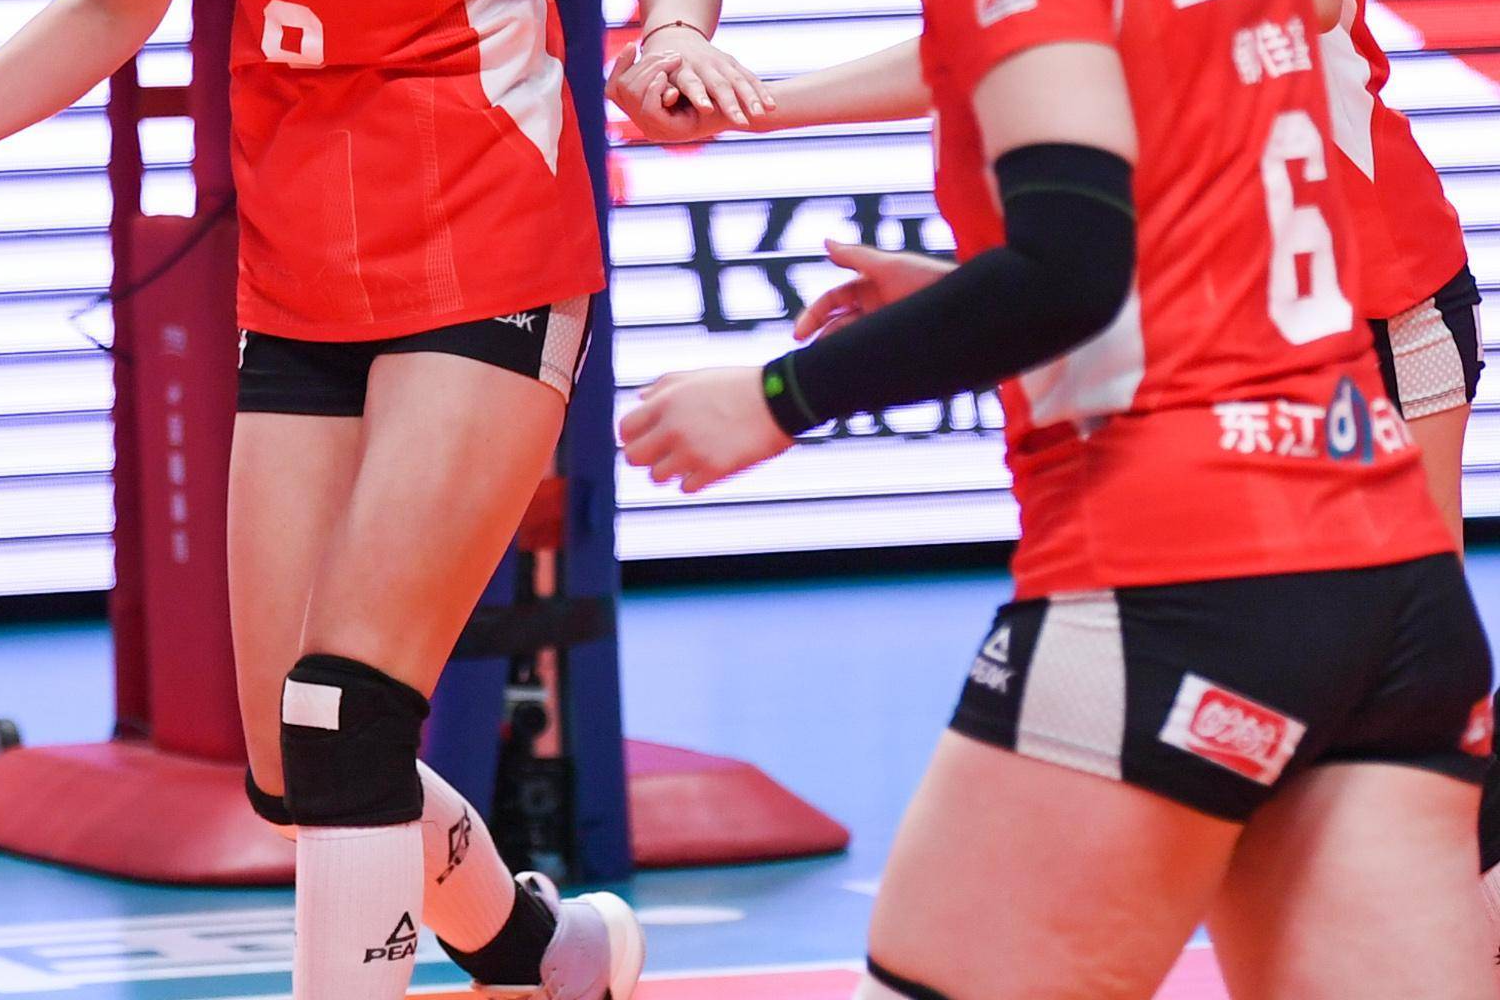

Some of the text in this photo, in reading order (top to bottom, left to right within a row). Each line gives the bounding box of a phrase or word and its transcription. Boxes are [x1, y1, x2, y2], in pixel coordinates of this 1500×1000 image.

[1261, 110, 1353, 346] 6
[1213, 398, 1328, 457] 东江
[363, 939, 418, 964] PEA
